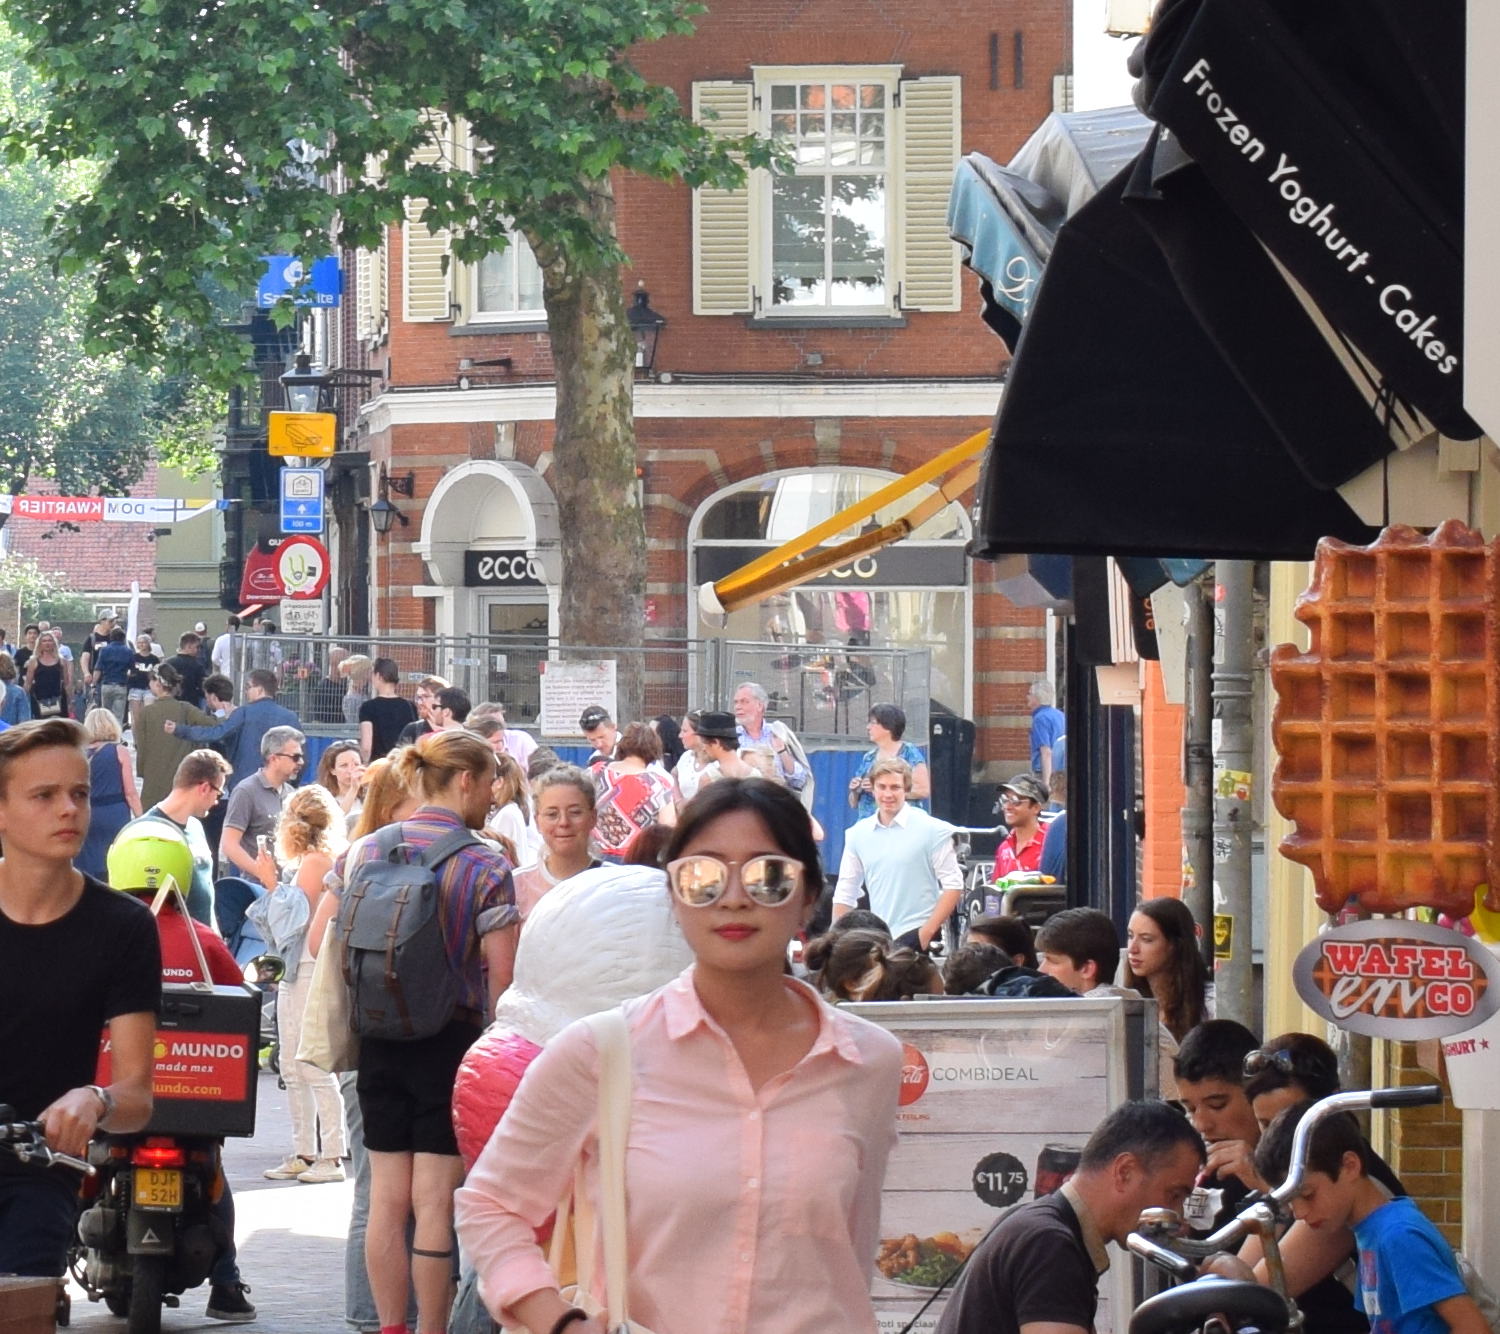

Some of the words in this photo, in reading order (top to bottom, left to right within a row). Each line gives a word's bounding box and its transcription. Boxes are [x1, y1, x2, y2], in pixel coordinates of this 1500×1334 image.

[1182, 58, 1266, 163] Frozen
[1267, 152, 1371, 272] Yoghurt
[1379, 284, 1458, 374] Cakes
[1322, 941, 1474, 981] WAFEL
[162, 968, 194, 977] UNDO
[1329, 975, 1426, 1018] en
[1425, 981, 1474, 1016] CO
[171, 1041, 244, 1059] MUNDO
[932, 1067, 1039, 1081] COMBIDEAL
[151, 1188, 178, 1203] 52H
[896, 1319, 936, 1331] spciaal
